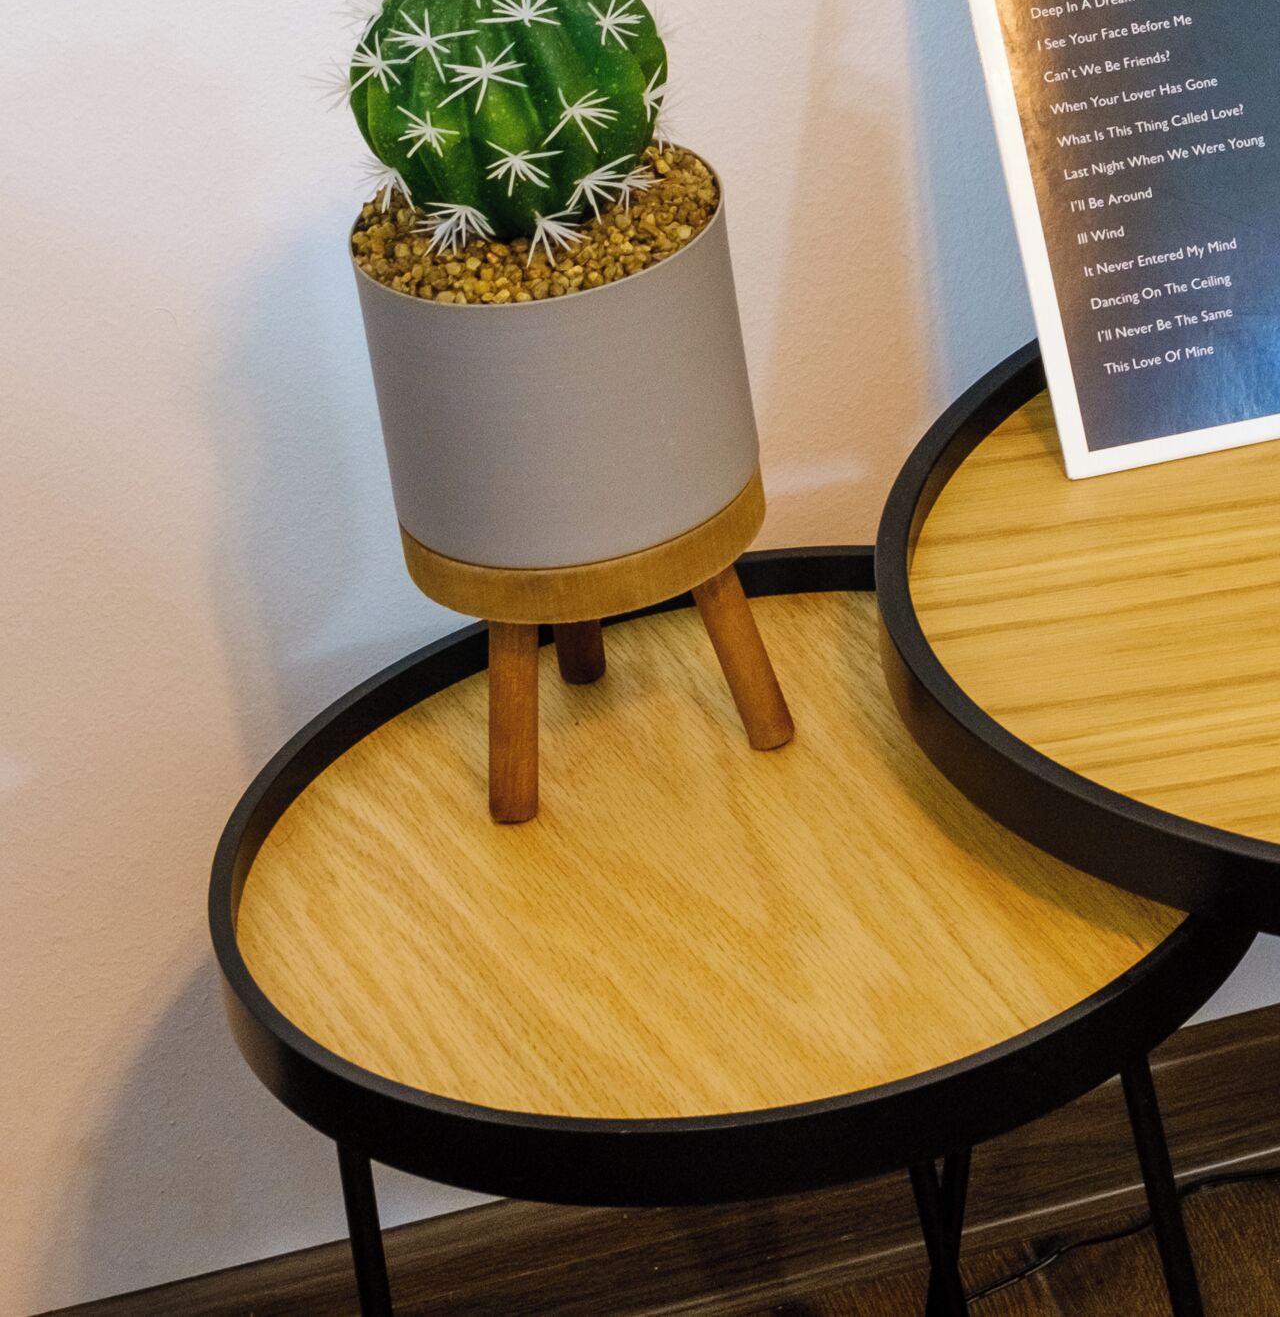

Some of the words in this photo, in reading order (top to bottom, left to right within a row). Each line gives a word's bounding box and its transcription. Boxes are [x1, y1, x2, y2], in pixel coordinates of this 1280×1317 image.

[1031, 6, 1063, 18] Deep
[1066, 2, 1078, 12] In
[1082, 0, 1091, 10] A
[1037, 41, 1041, 50] I
[1044, 38, 1066, 49] See
[1069, 33, 1098, 44] Your
[1101, 28, 1128, 40] Face
[1131, 21, 1170, 34] Before
[1173, 15, 1192, 26] Me
[1044, 68, 1077, 82] Can't
[1079, 64, 1102, 76] We
[1105, 61, 1120, 72] Be
[1123, 50, 1170, 68] Friends?
[1050, 102, 1087, 114] When
[1090, 96, 1119, 107] Your
[1122, 89, 1156, 102] Lover
[1159, 83, 1182, 95] Has
[1186, 78, 1217, 90] Gone
[1057, 134, 1092, 147] What
[1094, 130, 1104, 141] Is
[1106, 126, 1132, 138] This
[1135, 120, 1169, 133] Thing
[1171, 110, 1208, 126] Called
[1211, 104, 1243, 119] Love?
[1064, 168, 1089, 180] Last
[1092, 161, 1125, 175] Night
[1127, 155, 1164, 167] When
[1167, 148, 1189, 160] We
[1191, 143, 1225, 155] Were
[1228, 136, 1265, 149] Young
[1071, 200, 1085, 212] I'll
[1088, 198, 1104, 209] Be
[1109, 187, 1152, 205] Around
[1077, 232, 1088, 244] Ill
[1090, 226, 1124, 241] Wind
[1084, 266, 1094, 277] It
[1096, 260, 1134, 274] Never
[1137, 248, 1184, 267] Entered
[1187, 245, 1204, 259] My
[1208, 238, 1237, 253] Mind
[1091, 293, 1140, 309] Dancing
[1142, 288, 1161, 299] On
[1164, 283, 1187, 294] The
[1191, 276, 1232, 289] Ceiling
[1098, 329, 1112, 342] I'll
[1115, 324, 1153, 338] Never
[1156, 319, 1172, 331] Be
[1174, 315, 1198, 326] The
[1201, 309, 1233, 322] Same
[1104, 362, 1130, 374] This
[1132, 357, 1161, 369] Love
[1165, 349, 1181, 362] Of
[1185, 346, 1214, 358] Mine
